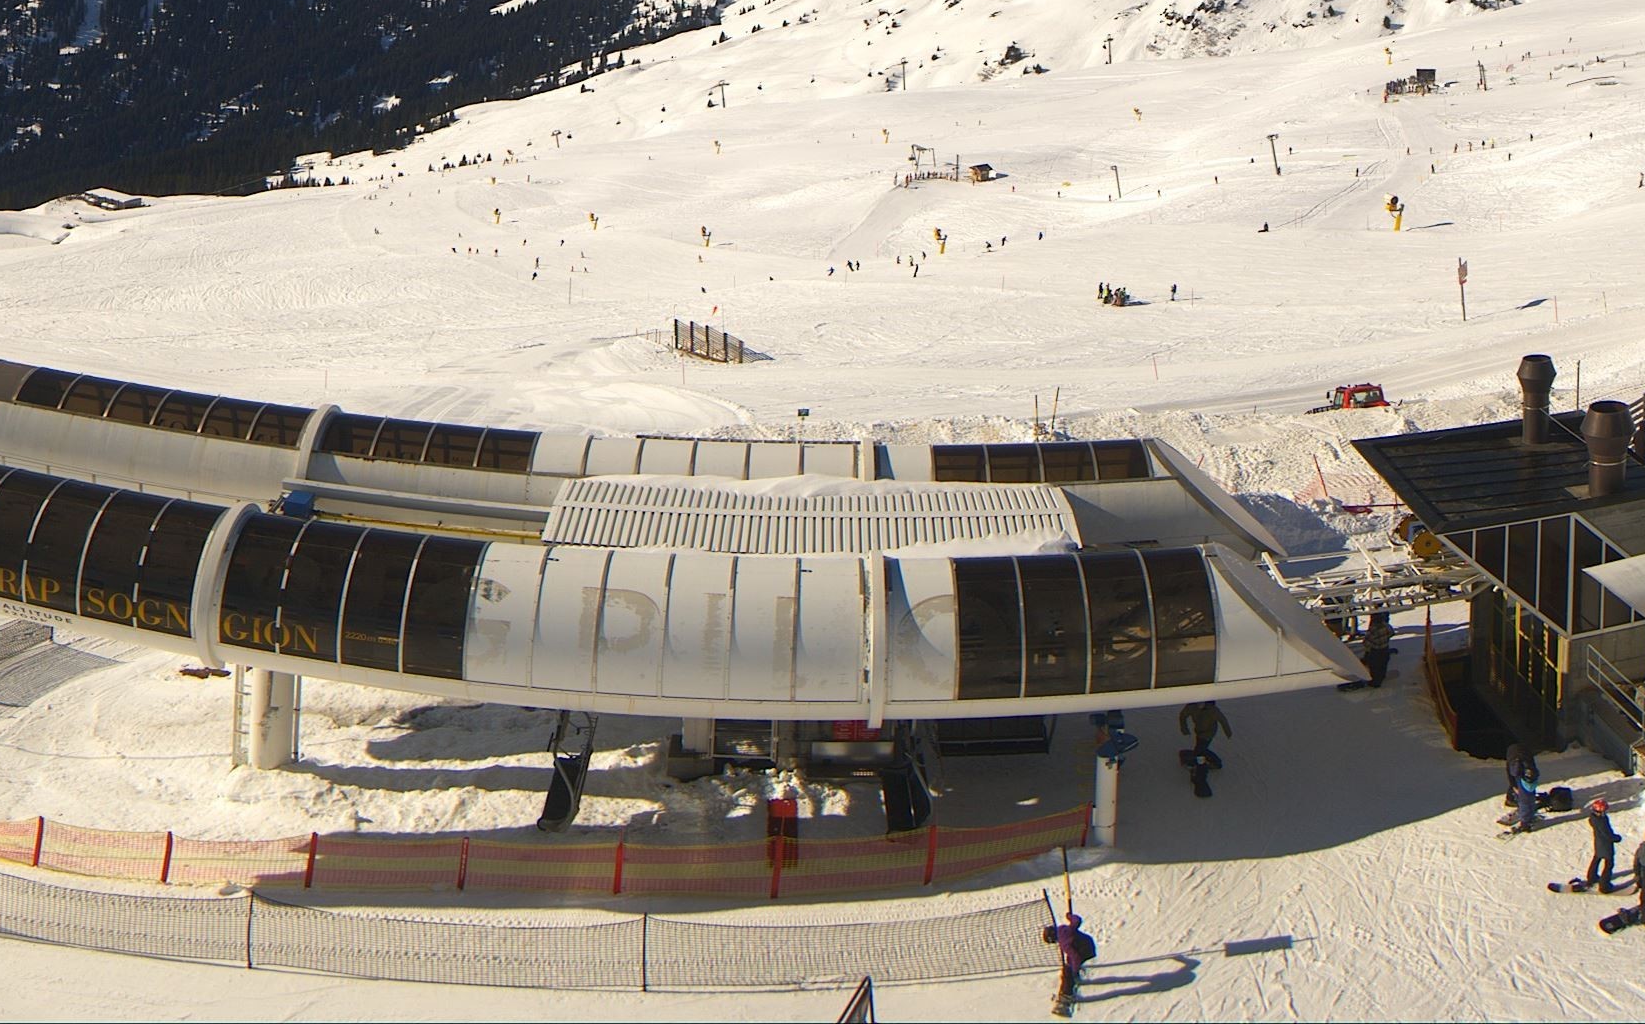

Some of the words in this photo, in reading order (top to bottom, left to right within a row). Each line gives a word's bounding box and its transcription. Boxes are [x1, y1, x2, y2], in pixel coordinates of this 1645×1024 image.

[3, 603, 73, 624] ALTITUDE
[87, 587, 191, 631] SOGN
[223, 613, 319, 653] GION
